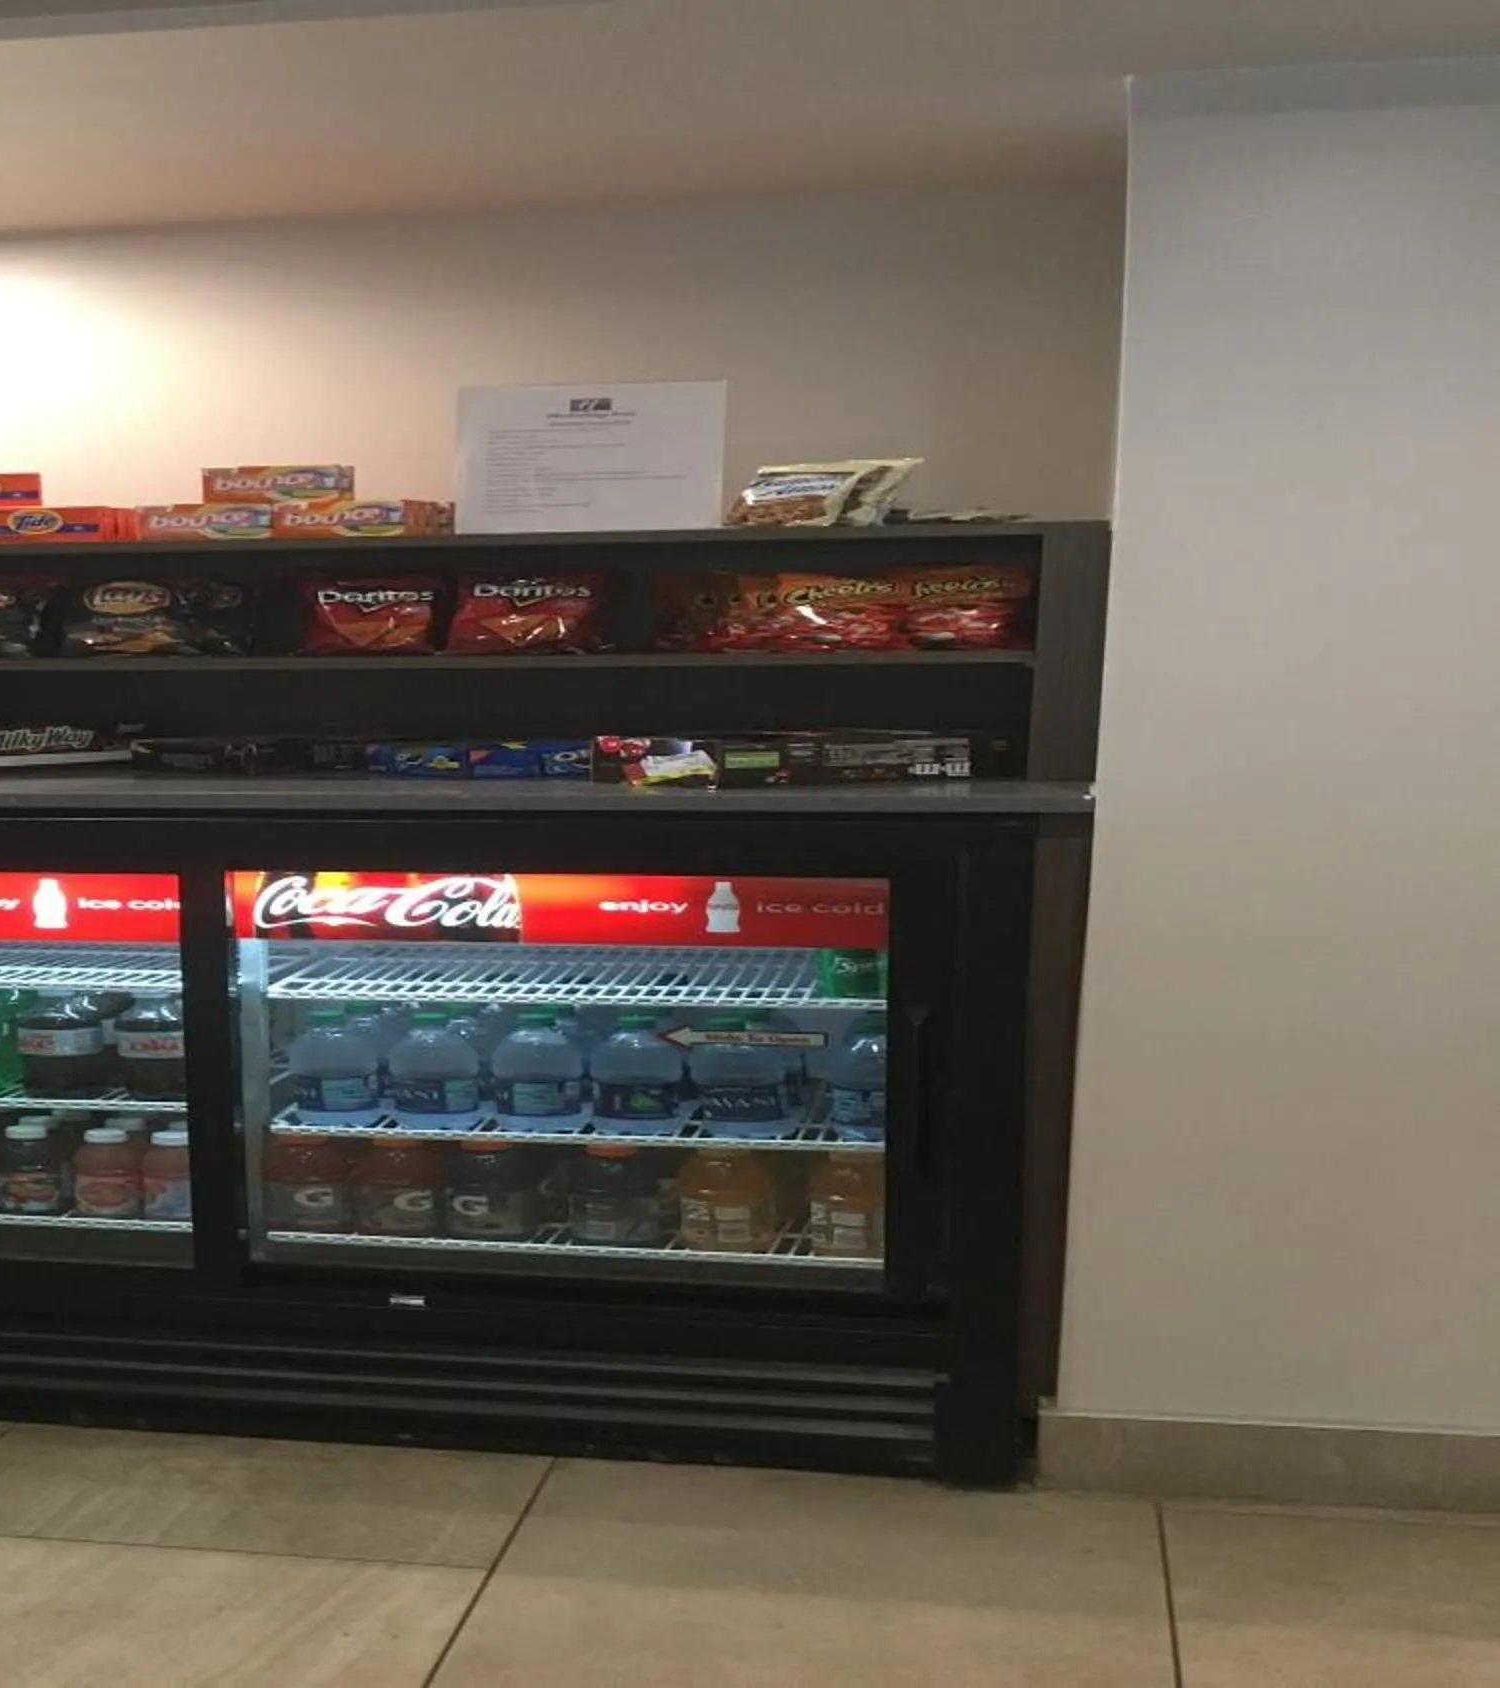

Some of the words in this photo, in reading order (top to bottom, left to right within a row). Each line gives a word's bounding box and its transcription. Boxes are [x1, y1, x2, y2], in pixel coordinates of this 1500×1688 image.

[213, 472, 315, 492] bounce
[16, 514, 60, 531] Tide
[151, 509, 249, 529] bounce
[282, 507, 380, 527] bounce
[317, 590, 435, 604] Doritos
[473, 582, 592, 598] Doritos
[787, 579, 893, 604] Cheetos
[912, 577, 999, 599] heetos
[47, 726, 95, 748] Way
[77, 897, 122, 910] ice
[253, 875, 522, 928] Coca-Cola
[598, 901, 688, 914] enjoy
[757, 902, 804, 914] ice
[811, 902, 885, 915] cold
[293, 1187, 333, 1208] G
[394, 1190, 434, 1211] G
[453, 1195, 490, 1216] G
